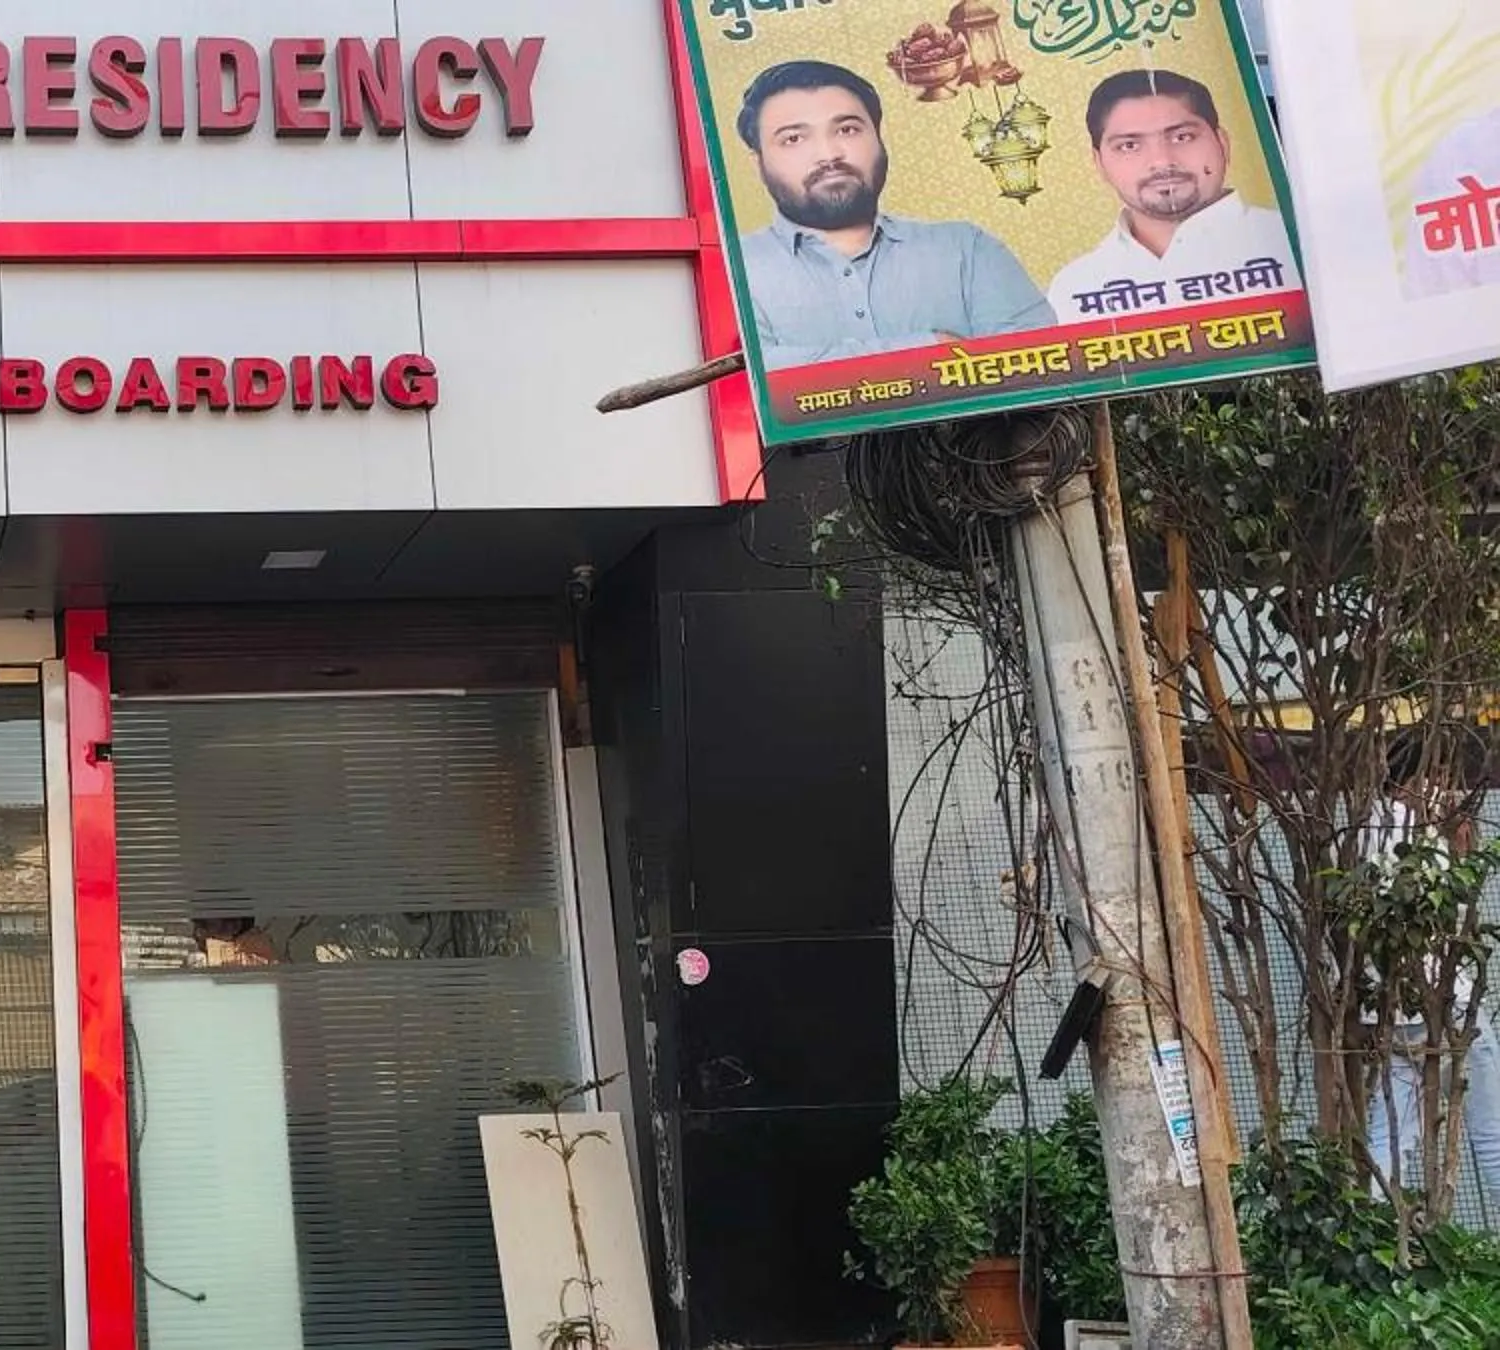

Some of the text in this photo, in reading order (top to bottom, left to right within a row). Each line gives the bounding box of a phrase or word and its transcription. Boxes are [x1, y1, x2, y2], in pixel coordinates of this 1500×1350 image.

[1071, 256, 1285, 315] मतीन हाशमी
[795, 387, 853, 414] समाज
[856, 378, 914, 403] सेवक
[931, 342, 1072, 388] मोहम्मद
[1077, 322, 1194, 372] इमरान
[1199, 308, 1287, 350] खान
